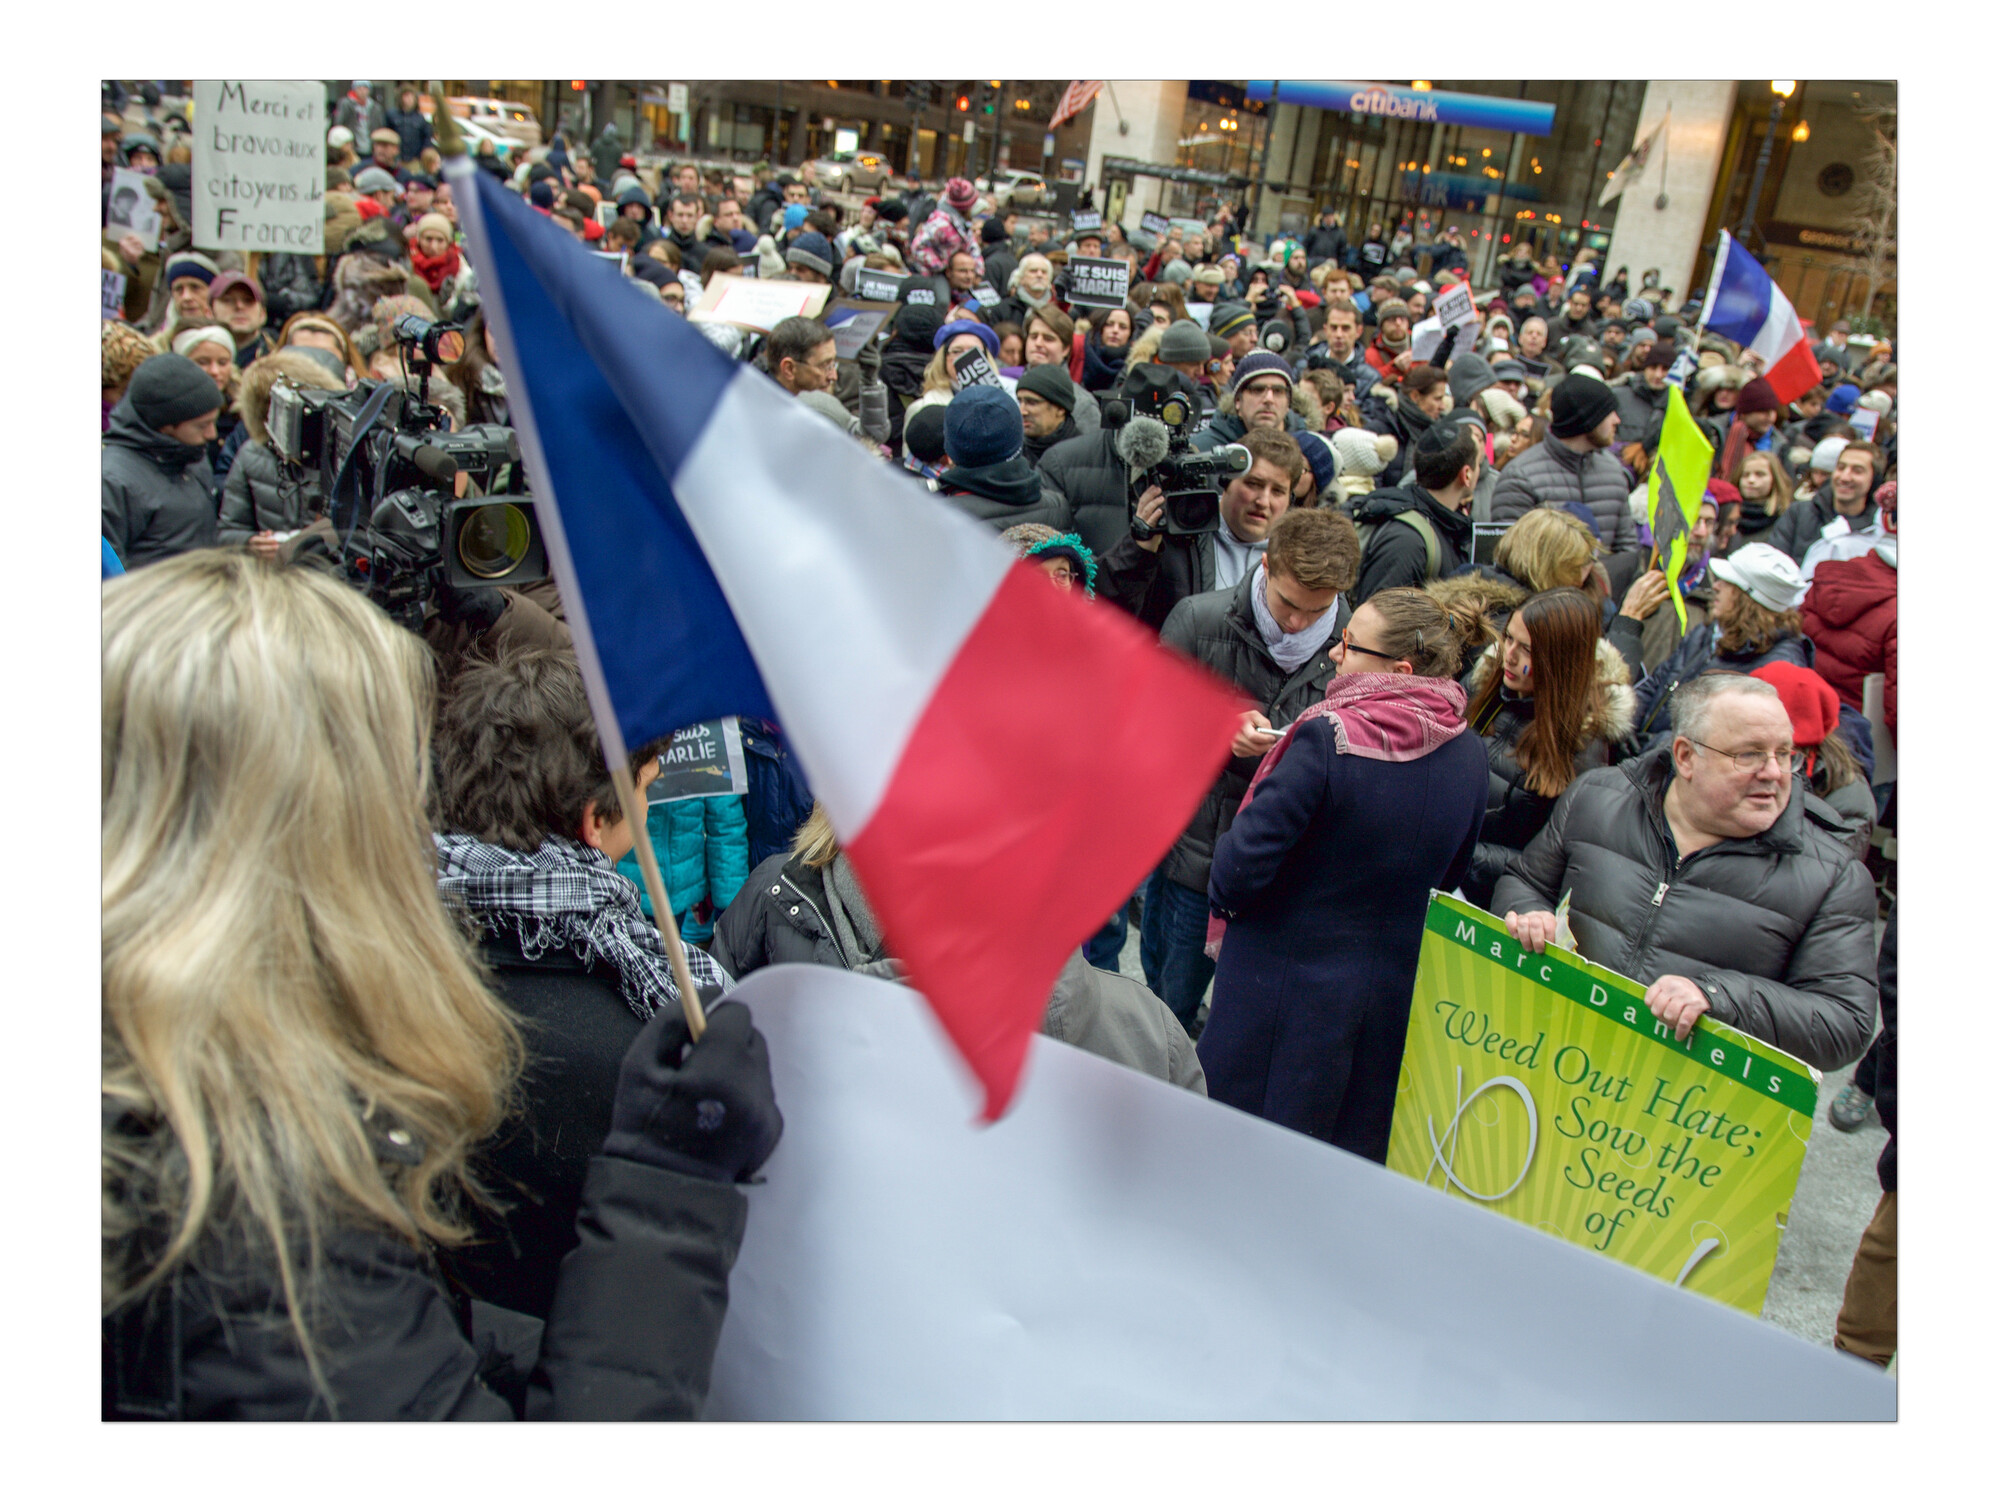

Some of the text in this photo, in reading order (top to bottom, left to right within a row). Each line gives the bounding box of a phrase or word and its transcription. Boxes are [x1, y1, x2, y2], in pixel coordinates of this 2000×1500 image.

[218, 80, 314, 120] Merci et
[1350, 88, 1439, 121] citibank
[213, 124, 317, 159] bravo aux
[208, 172, 323, 208] citoyens de
[1071, 264, 1127, 282] JE SUIS
[1071, 278, 1127, 298] HARLIE
[955, 358, 989, 391] UIS
[1455, 920, 1782, 1093] Marc Daniels
[1435, 1000, 1763, 1158] Weed Out Hate;
[1554, 1096, 1647, 1156] Sow
[1656, 1137, 1722, 1188] the
[1564, 1147, 1676, 1219] Seeds
[1585, 1208, 1636, 1251] of
